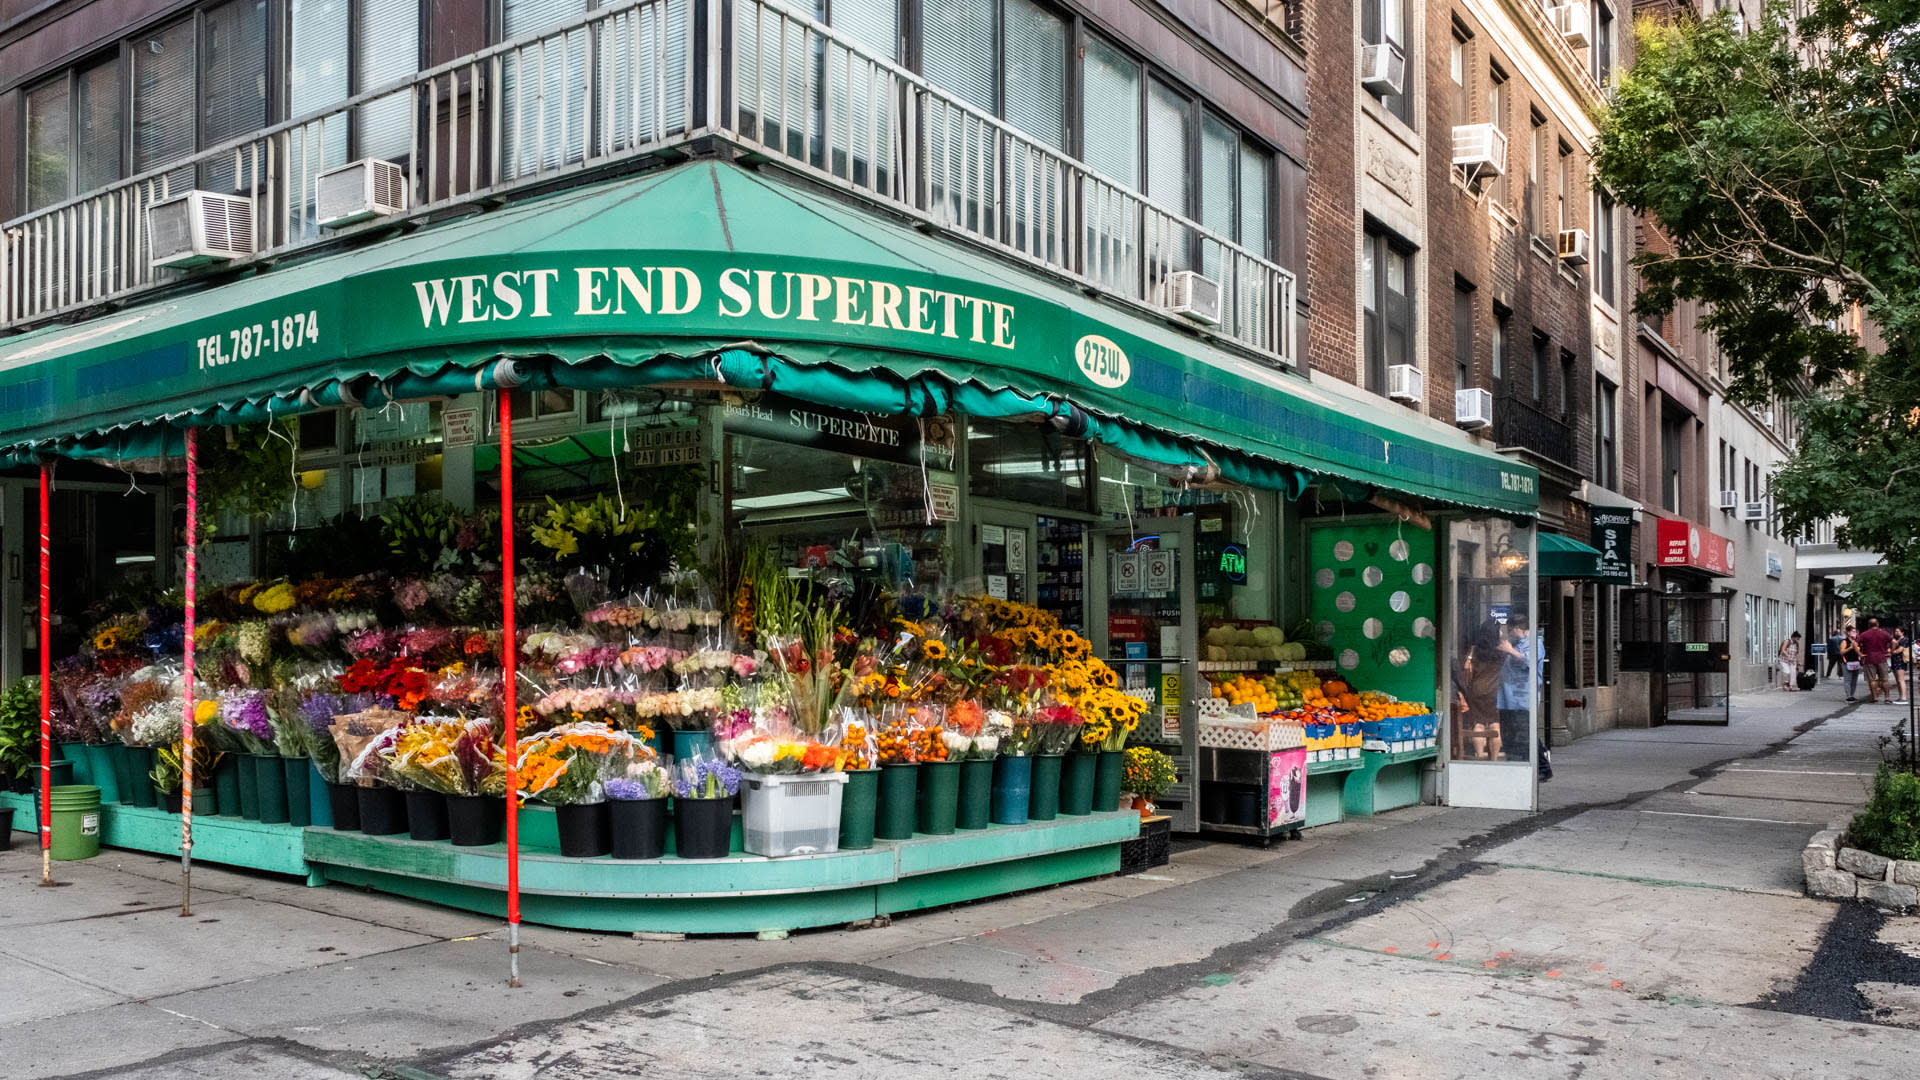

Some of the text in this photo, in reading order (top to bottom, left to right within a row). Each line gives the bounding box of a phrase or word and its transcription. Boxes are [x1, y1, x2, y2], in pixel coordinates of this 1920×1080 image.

[412, 266, 1016, 350] WEST END SUPERETTE
[197, 310, 319, 370] TEL.787-1874
[1083, 339, 1124, 382] 273W.
[751, 405, 773, 421] Head
[789, 408, 900, 447] SUPERETTE
[635, 429, 702, 447] FLOWERS
[635, 446, 701, 465] PAY INSIDE
[1603, 528, 1619, 560] SPA
[1220, 553, 1245, 575] ATM
